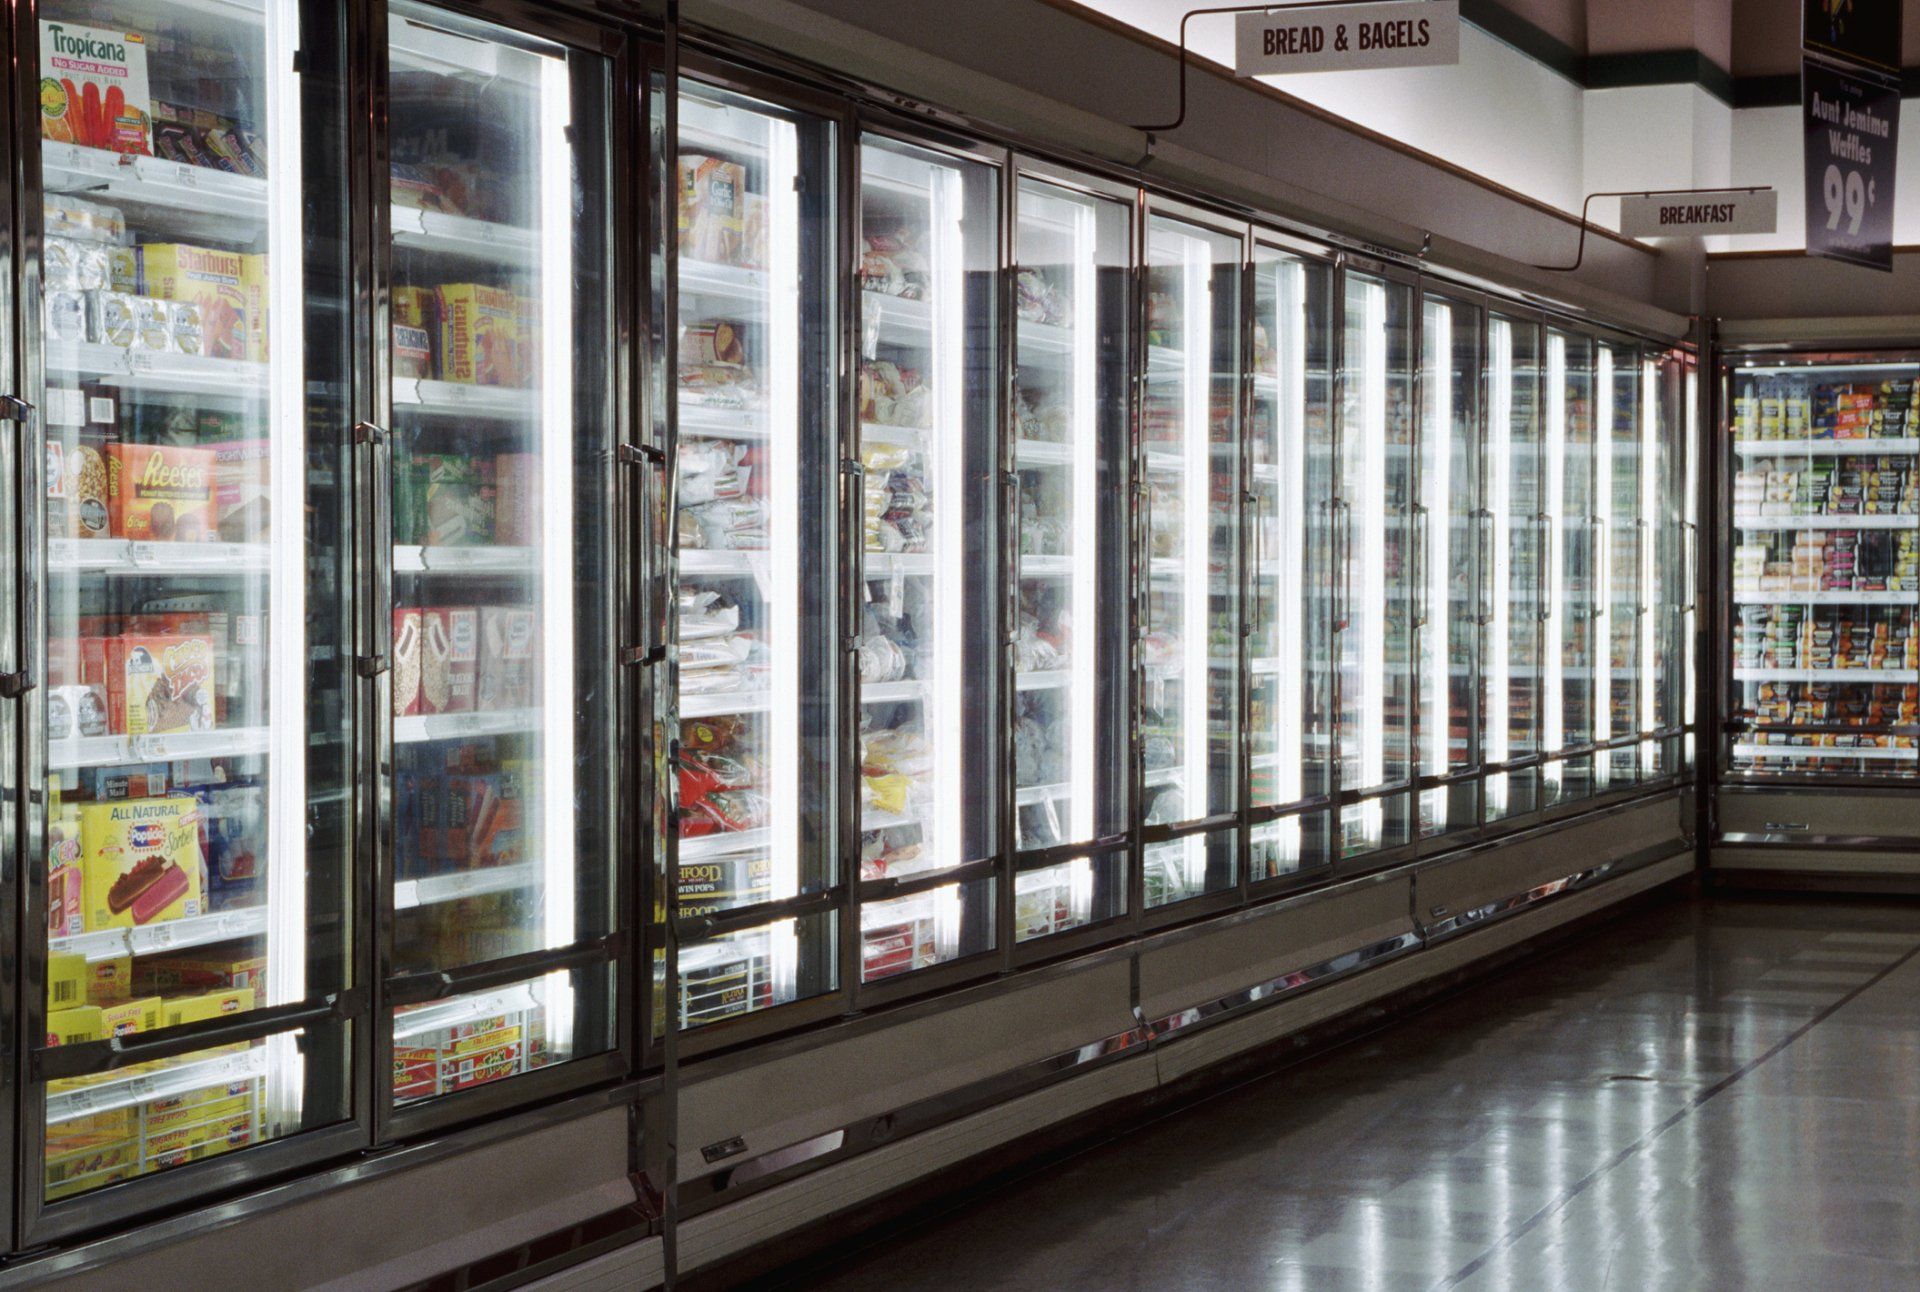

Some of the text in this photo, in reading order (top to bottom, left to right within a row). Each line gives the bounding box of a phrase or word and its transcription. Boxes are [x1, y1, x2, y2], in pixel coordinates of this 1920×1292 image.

[48, 24, 126, 61] Tropicana
[1263, 19, 1430, 55] BREAD & BAGELS
[1812, 91, 1889, 138] Aunt Jemima
[1829, 129, 1872, 165] Waffles
[1660, 204, 1736, 225] BREAKFAST
[177, 245, 243, 277] Starburst
[111, 807, 131, 820] ALL
[133, 804, 180, 819] NATURAL
[695, 883, 715, 892] POPS
